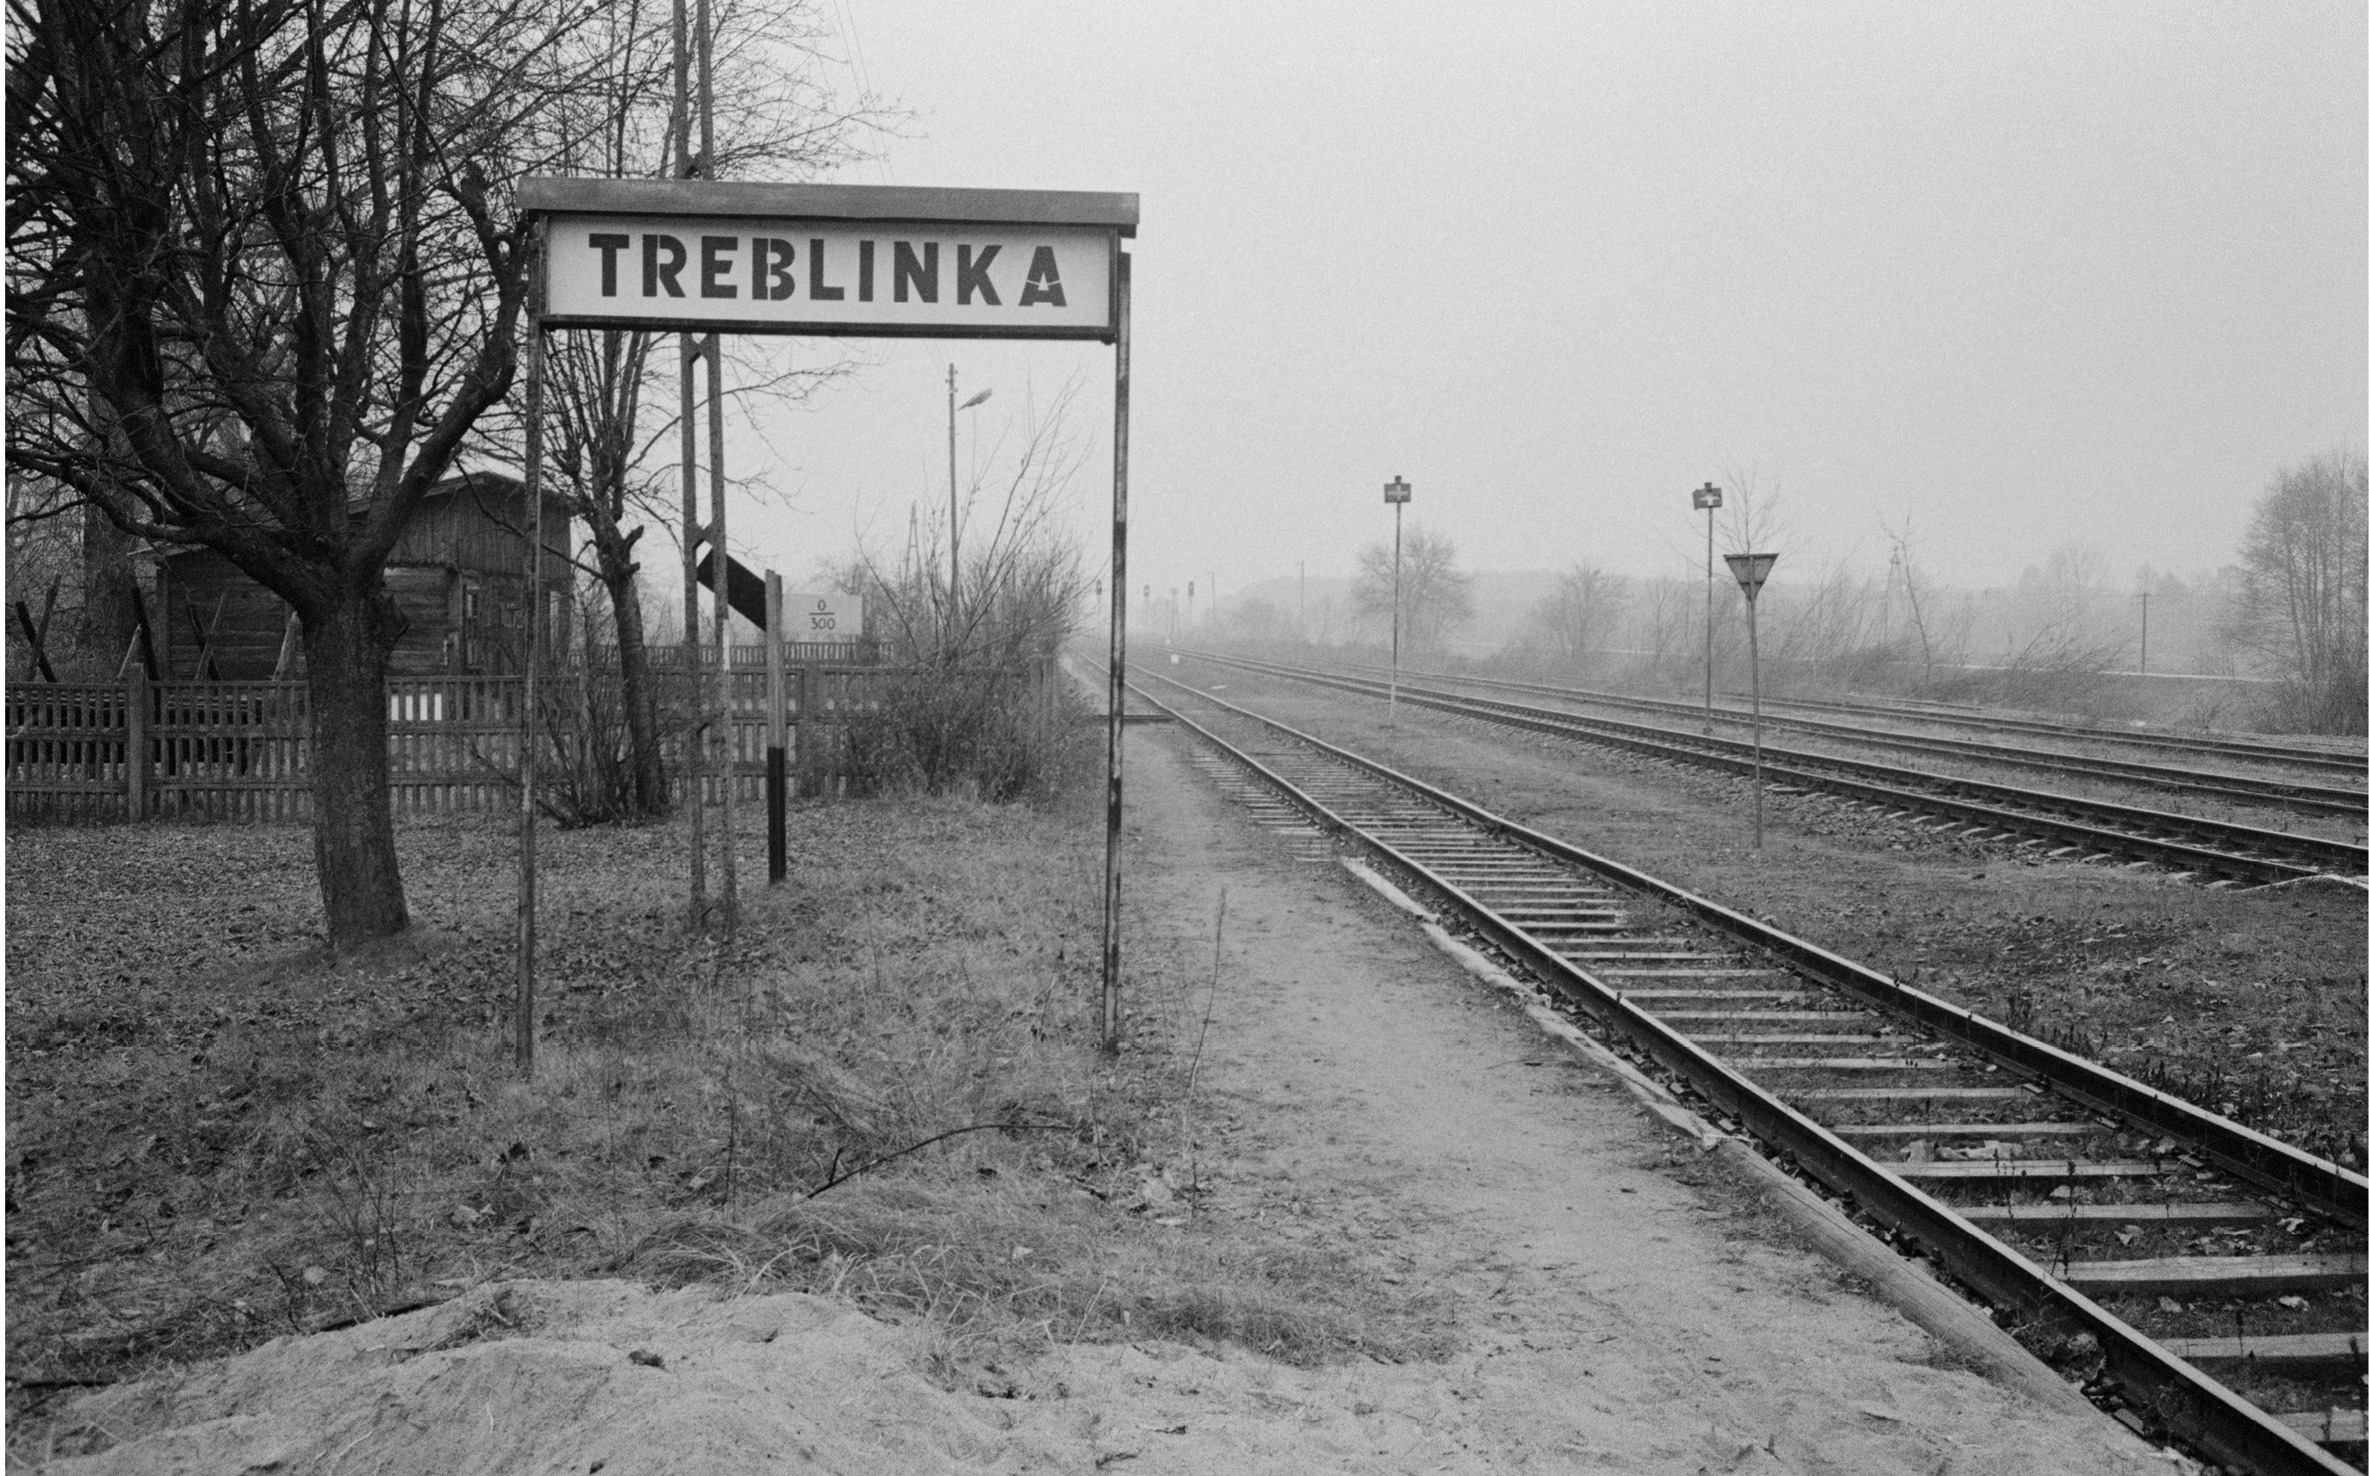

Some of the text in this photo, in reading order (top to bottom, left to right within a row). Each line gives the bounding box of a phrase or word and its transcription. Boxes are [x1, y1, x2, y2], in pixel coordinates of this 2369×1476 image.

[588, 232, 1068, 308] TREBLINKA
[817, 599, 827, 611] 0
[810, 617, 836, 630] 300
